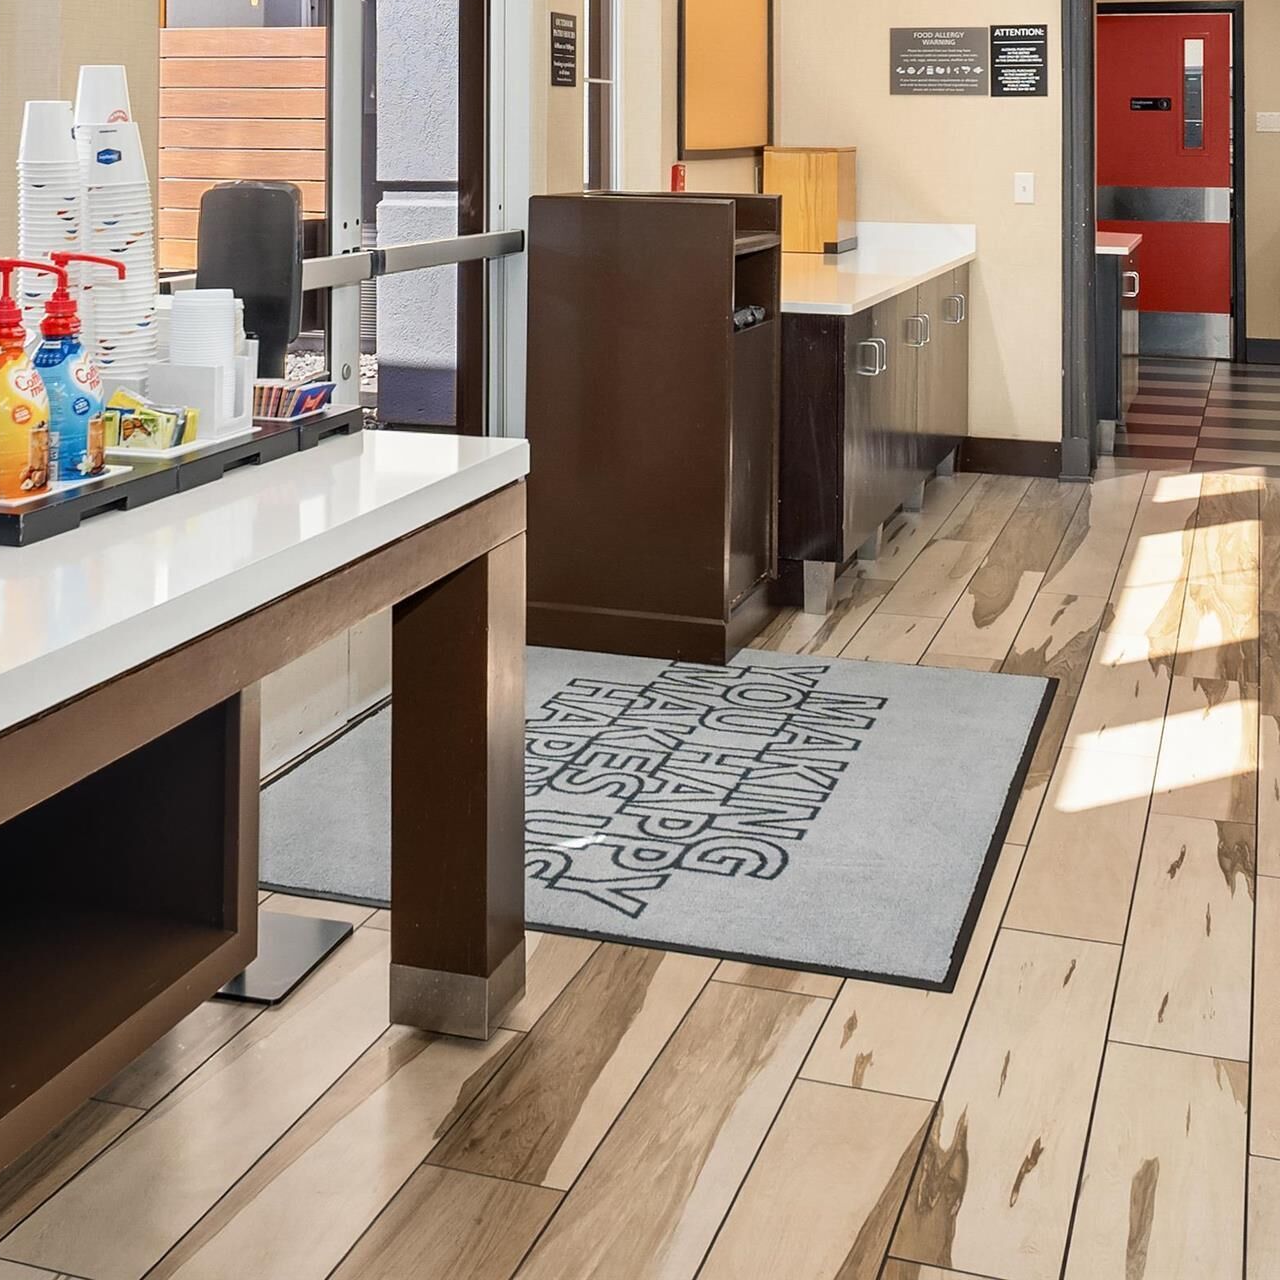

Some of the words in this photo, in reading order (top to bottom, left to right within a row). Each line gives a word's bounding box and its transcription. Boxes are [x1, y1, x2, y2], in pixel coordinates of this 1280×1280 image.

[934, 31, 965, 39] ALLERGY
[994, 28, 1045, 37] ATTENTION:
[549, 659, 752, 801] MAKES
[697, 665, 831, 737] YOU
[546, 741, 753, 919] HAPPY
[679, 690, 888, 881] MAKING
